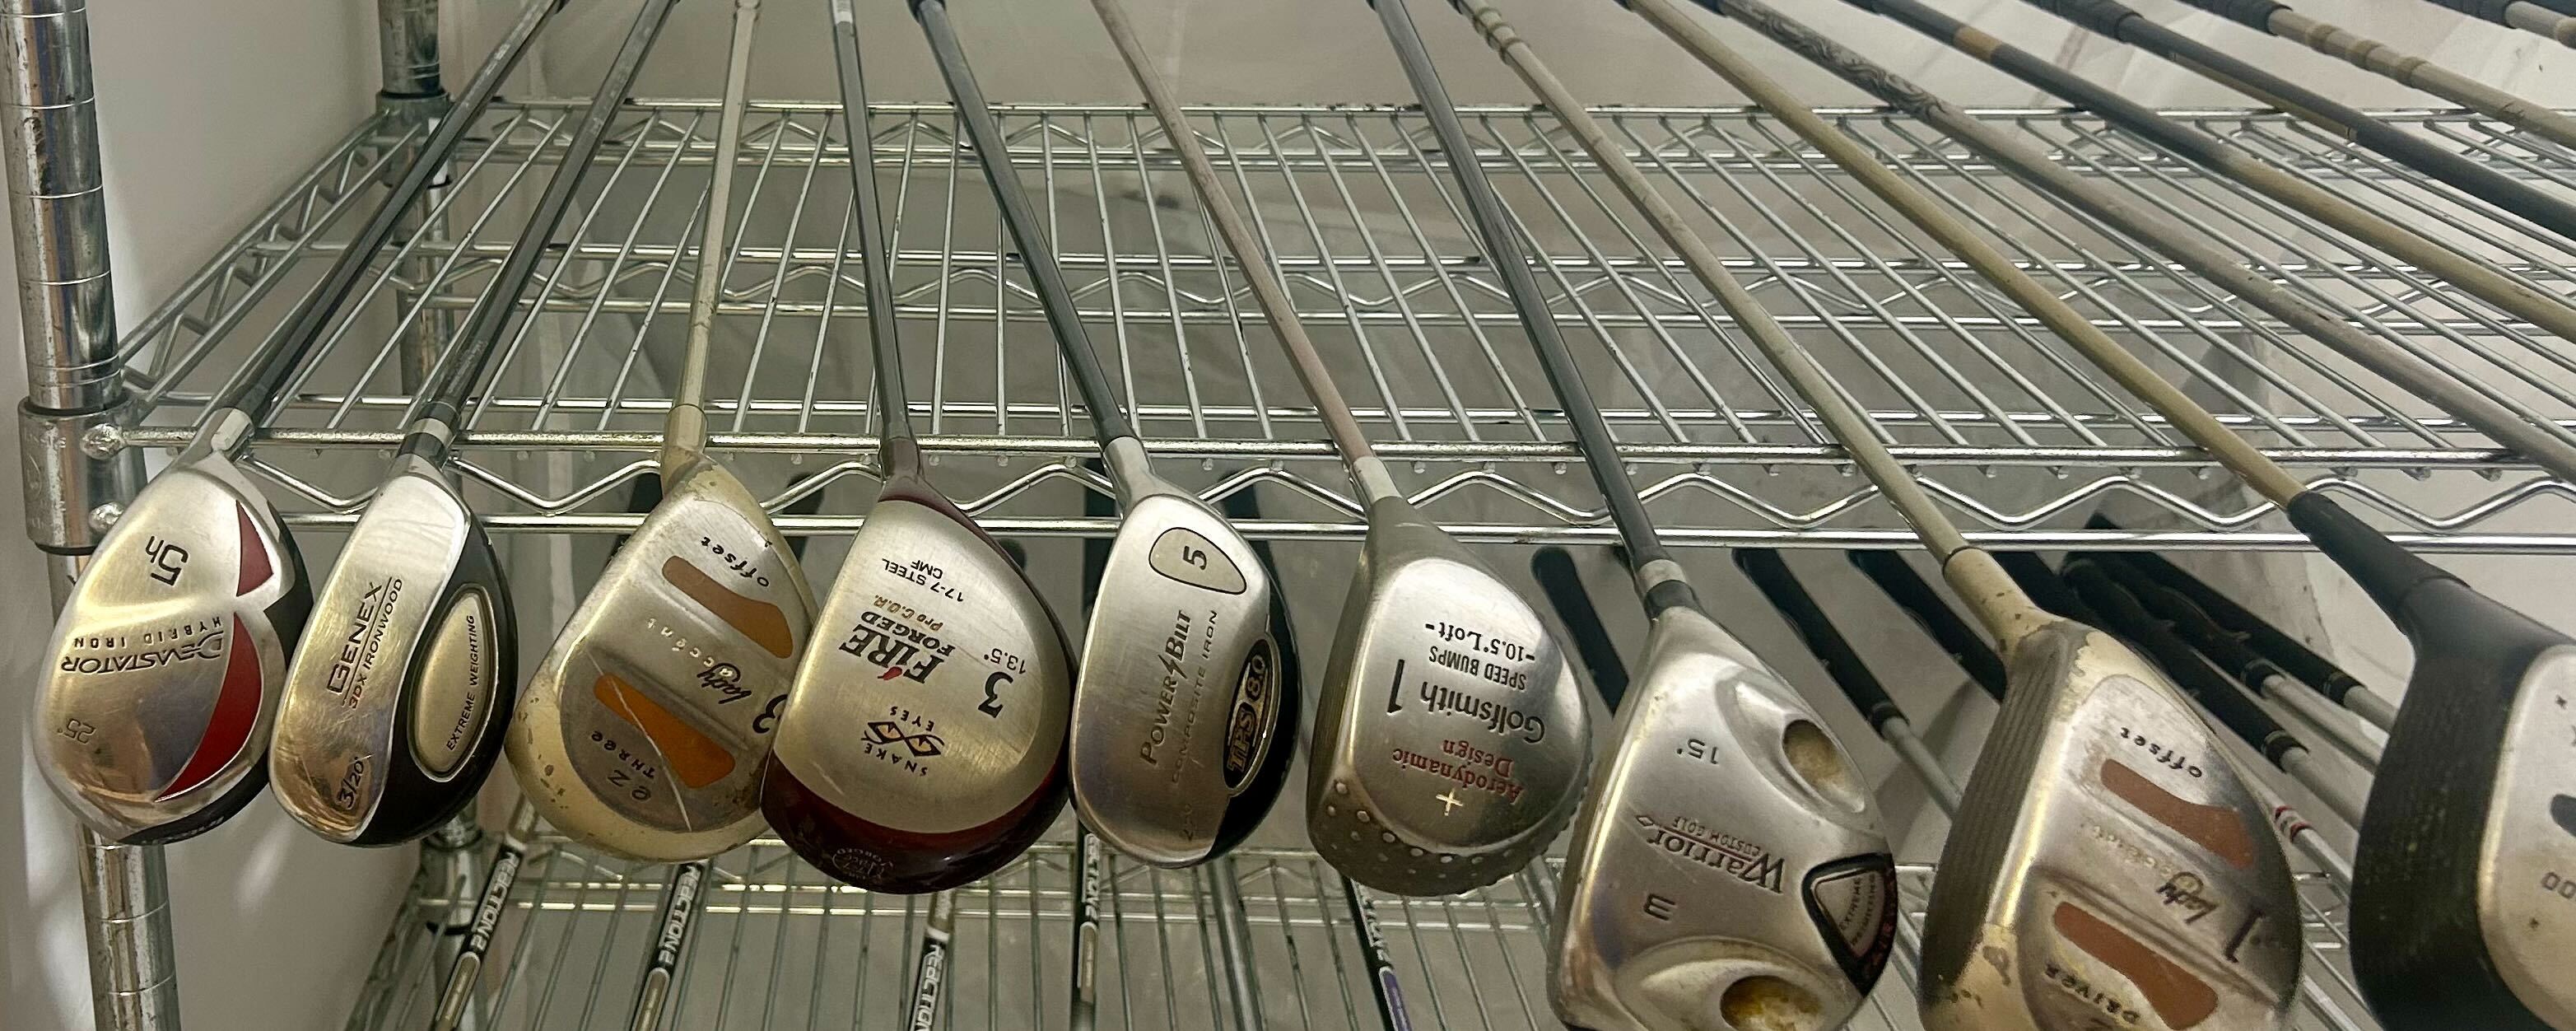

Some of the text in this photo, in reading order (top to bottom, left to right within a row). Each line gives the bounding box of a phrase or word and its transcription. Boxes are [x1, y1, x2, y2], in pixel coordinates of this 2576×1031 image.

[146, 536, 189, 585] 5h
[701, 536, 770, 587] offset
[881, 558, 964, 603] 17-7 STEEL
[910, 560, 943, 580] CMF
[1182, 545, 1208, 571] 5
[73, 637, 126, 648] IRON
[327, 581, 382, 694] GENEX
[362, 578, 403, 671] IRONWOOD
[860, 611, 957, 656] FORGED
[917, 613, 943, 632] Pro
[61, 630, 225, 674] DEVASTATOR
[1428, 646, 1527, 691] SPEED BUMPS
[447, 615, 479, 751] EXTREME WEIGHTING
[977, 670, 1014, 719] 3
[1172, 665, 1206, 785] COMPOSITE
[1202, 609, 1218, 660] IRON
[1387, 659, 1405, 714] 1
[752, 693, 788, 735] 3
[889, 706, 935, 731] EYES
[1420, 681, 1545, 744] Golfsmith
[864, 742, 929, 777] SNAKE
[1227, 702, 1256, 773] TPS
[1442, 739, 1514, 778] Design
[2120, 726, 2203, 778] offset
[1392, 747, 1525, 805] Aerodynamic
[1647, 829, 1785, 894] Warrior
[2223, 908, 2265, 963] 1
